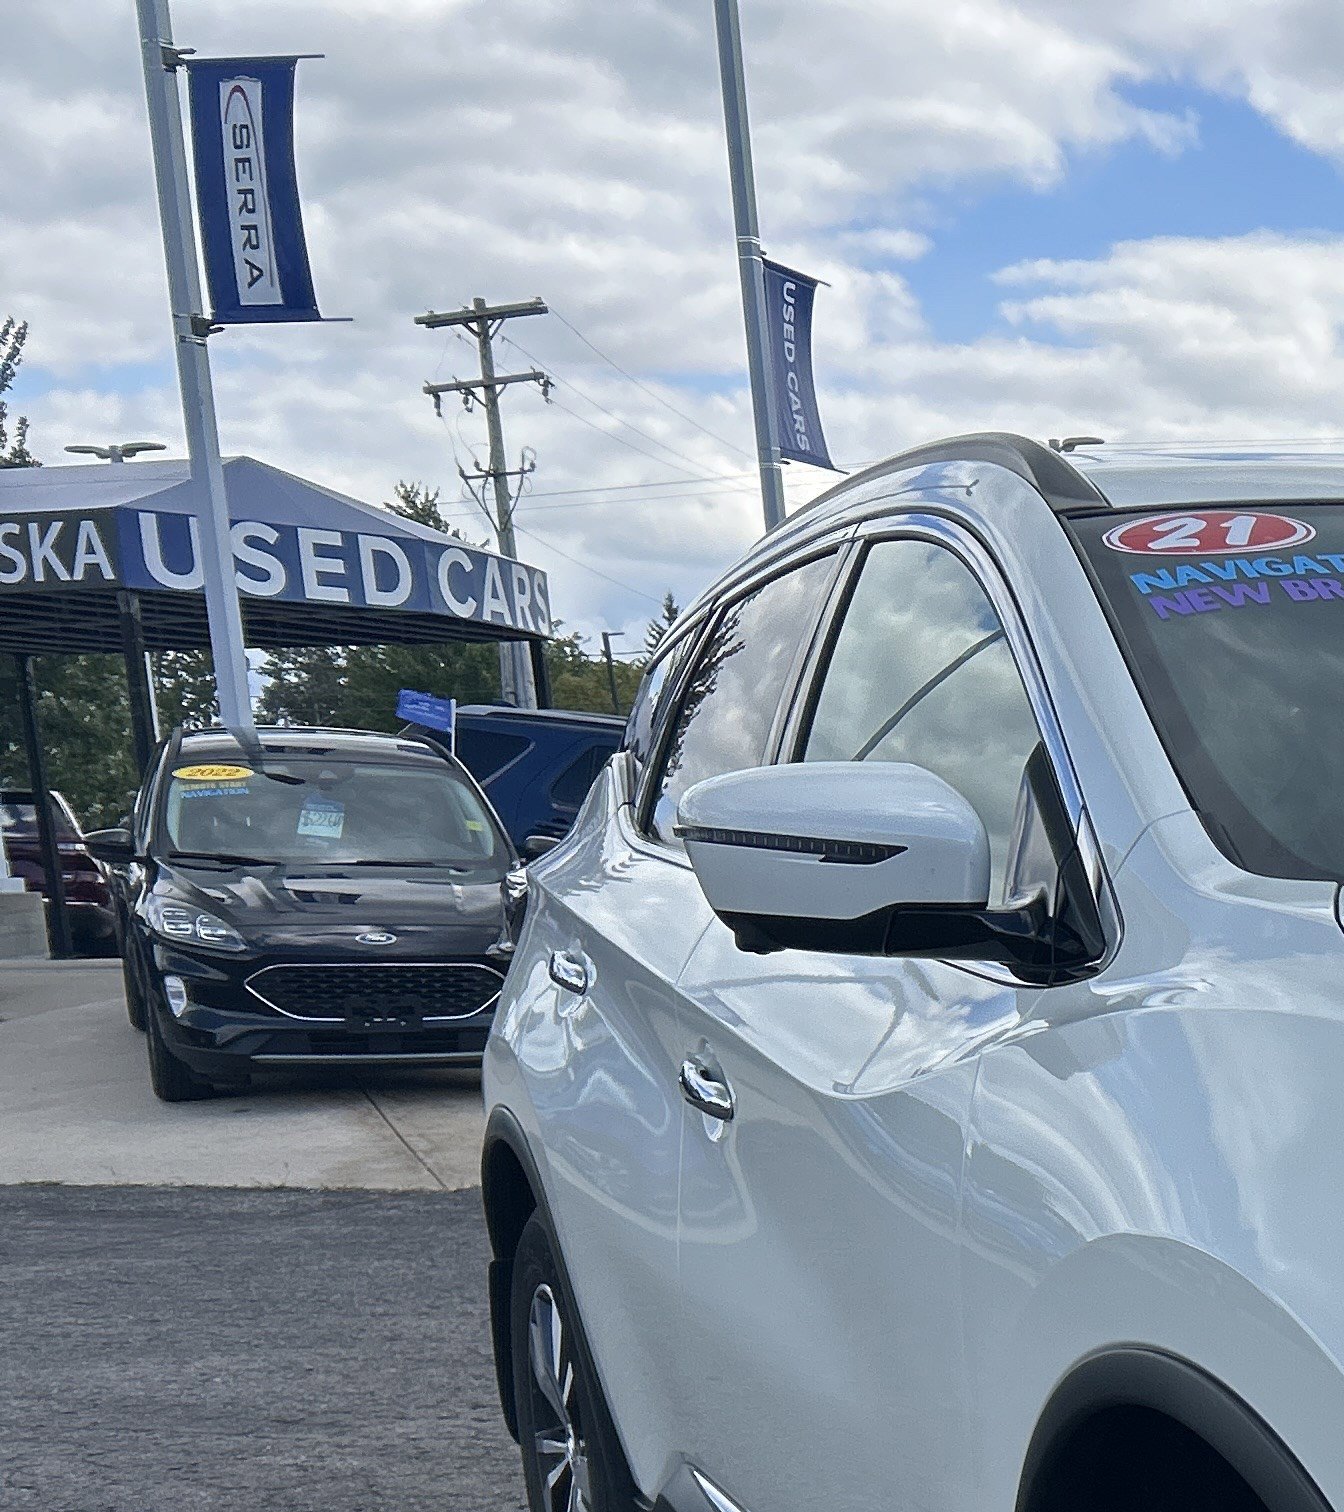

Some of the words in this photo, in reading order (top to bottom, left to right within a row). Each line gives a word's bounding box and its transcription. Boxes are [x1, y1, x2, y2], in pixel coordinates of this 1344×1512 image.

[231, 122, 264, 289] SERRA
[782, 281, 796, 363] USED
[787, 371, 810, 451] CARS
[0, 520, 116, 584] SKA
[1147, 515, 1257, 550] 21
[138, 511, 412, 607] USED
[437, 548, 551, 637] CARS
[1150, 581, 1271, 620] NEW
[186, 767, 241, 777] 2022
